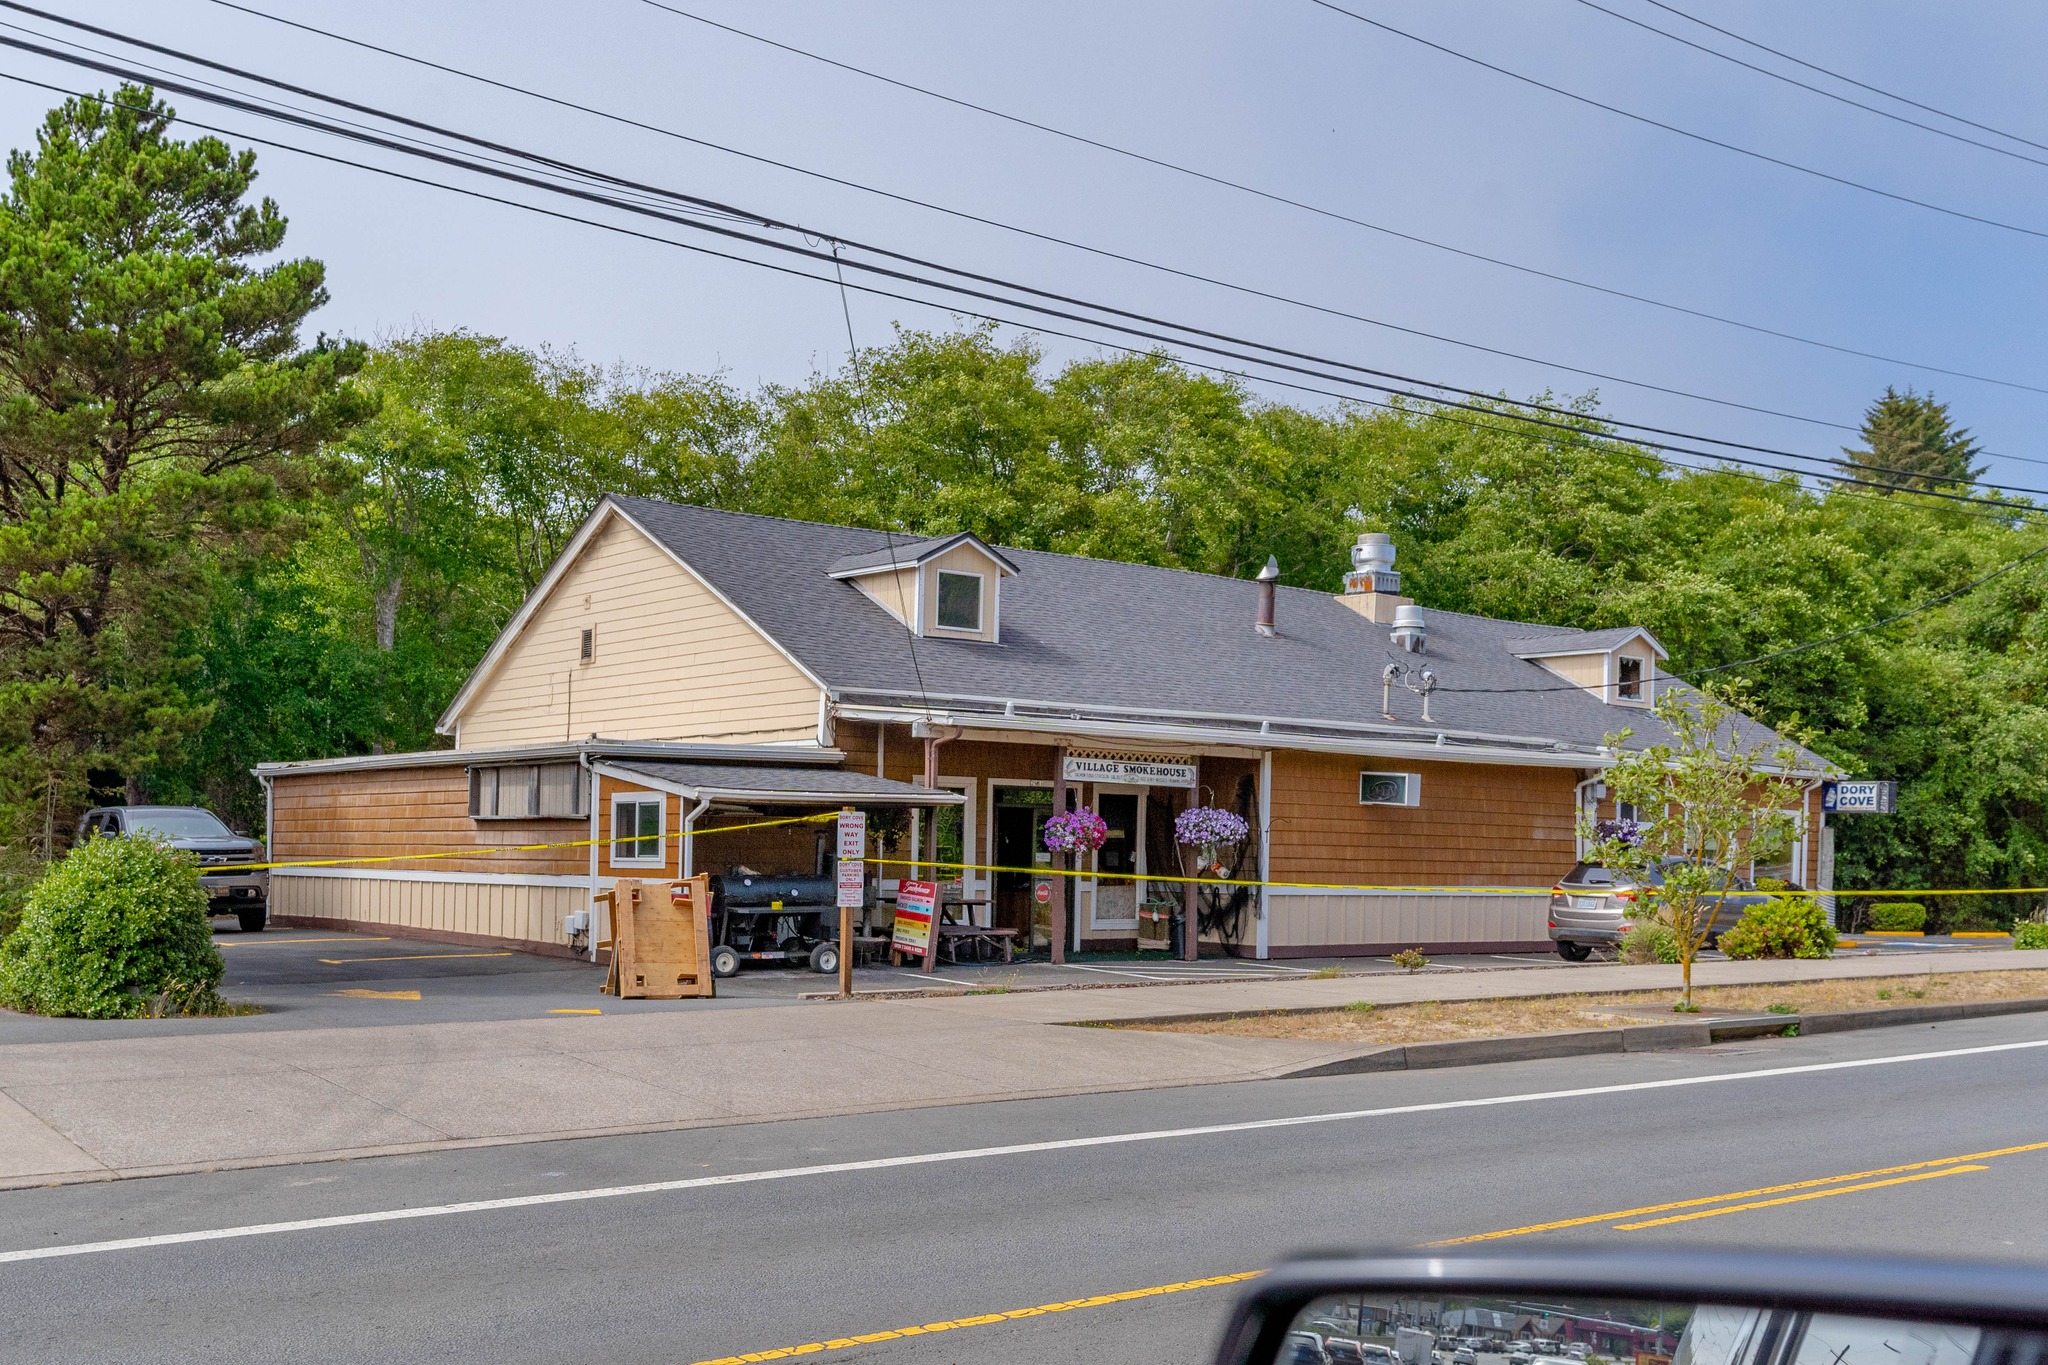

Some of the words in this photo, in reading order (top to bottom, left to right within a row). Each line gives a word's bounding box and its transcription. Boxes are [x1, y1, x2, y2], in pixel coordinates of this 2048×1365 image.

[1076, 762, 1120, 773] VILLAGE
[1124, 765, 1186, 778] SMOKEHOUSE
[1841, 786, 1875, 794] DORY
[1840, 796, 1874, 806] COVE
